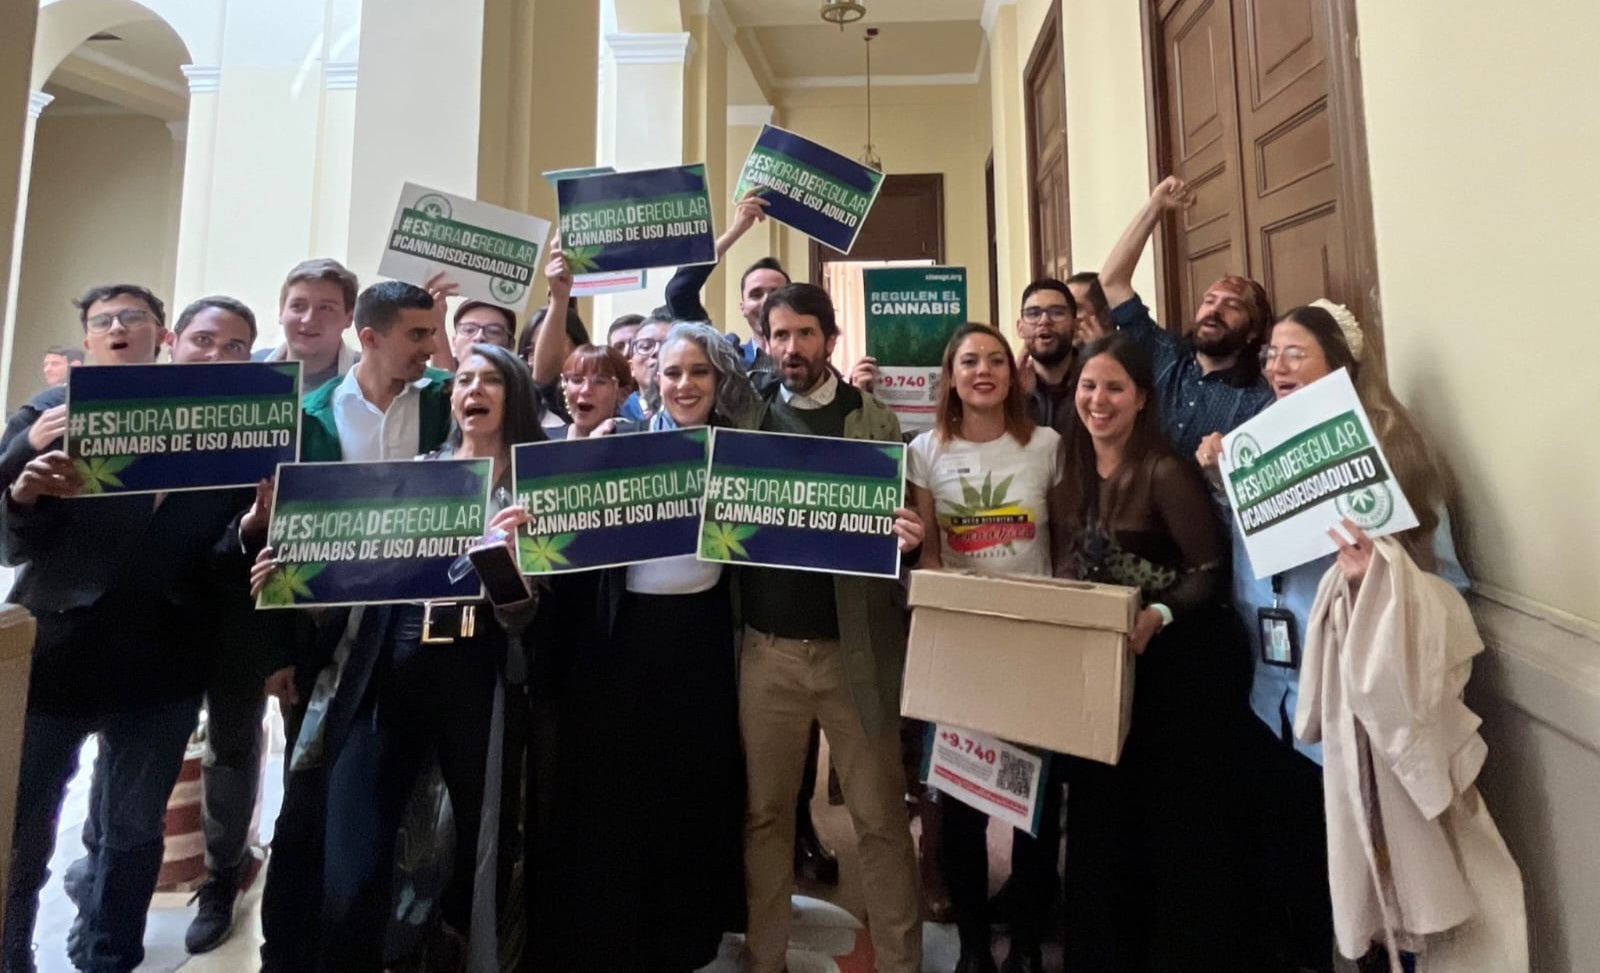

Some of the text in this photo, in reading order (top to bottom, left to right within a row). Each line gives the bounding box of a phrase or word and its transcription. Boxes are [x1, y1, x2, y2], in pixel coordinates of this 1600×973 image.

[745, 168, 858, 228] CANNABIS DE USO ADULTO
[747, 153, 867, 215] #ESHORADEREGULAR
[560, 197, 708, 233] #ESHORADEREGULAR
[568, 218, 708, 247] CANNABIS DE USO ADULTO
[392, 231, 529, 281] #CANNABISDEUSOADULTO
[401, 215, 535, 263] #ESHORADEREGULAR
[871, 290, 961, 302] REGULEN EL
[871, 302, 961, 315] CANNABIS
[69, 401, 294, 436] #ESHORADEREGULAR
[80, 429, 290, 458] CANNABIS DE USO ADULTO
[1235, 420, 1363, 505] #ESHORADEREGULAR
[518, 469, 706, 515] #ESHORADEREGULAR
[708, 476, 897, 510] #ESHORADEREGULAR
[1240, 454, 1376, 531] #CANNABISDEUSOADULTO
[271, 504, 481, 541] #ESHORADEREGULAR
[527, 509, 601, 536] CANNABIS
[604, 508, 623, 527] DE
[626, 504, 653, 524] USO
[714, 502, 893, 535] CANNABIS DE USO ADULTO
[277, 539, 355, 563] CANNABIS
[358, 538, 379, 561] DE
[383, 537, 413, 559] USO
[940, 730, 996, 765] +9.740
